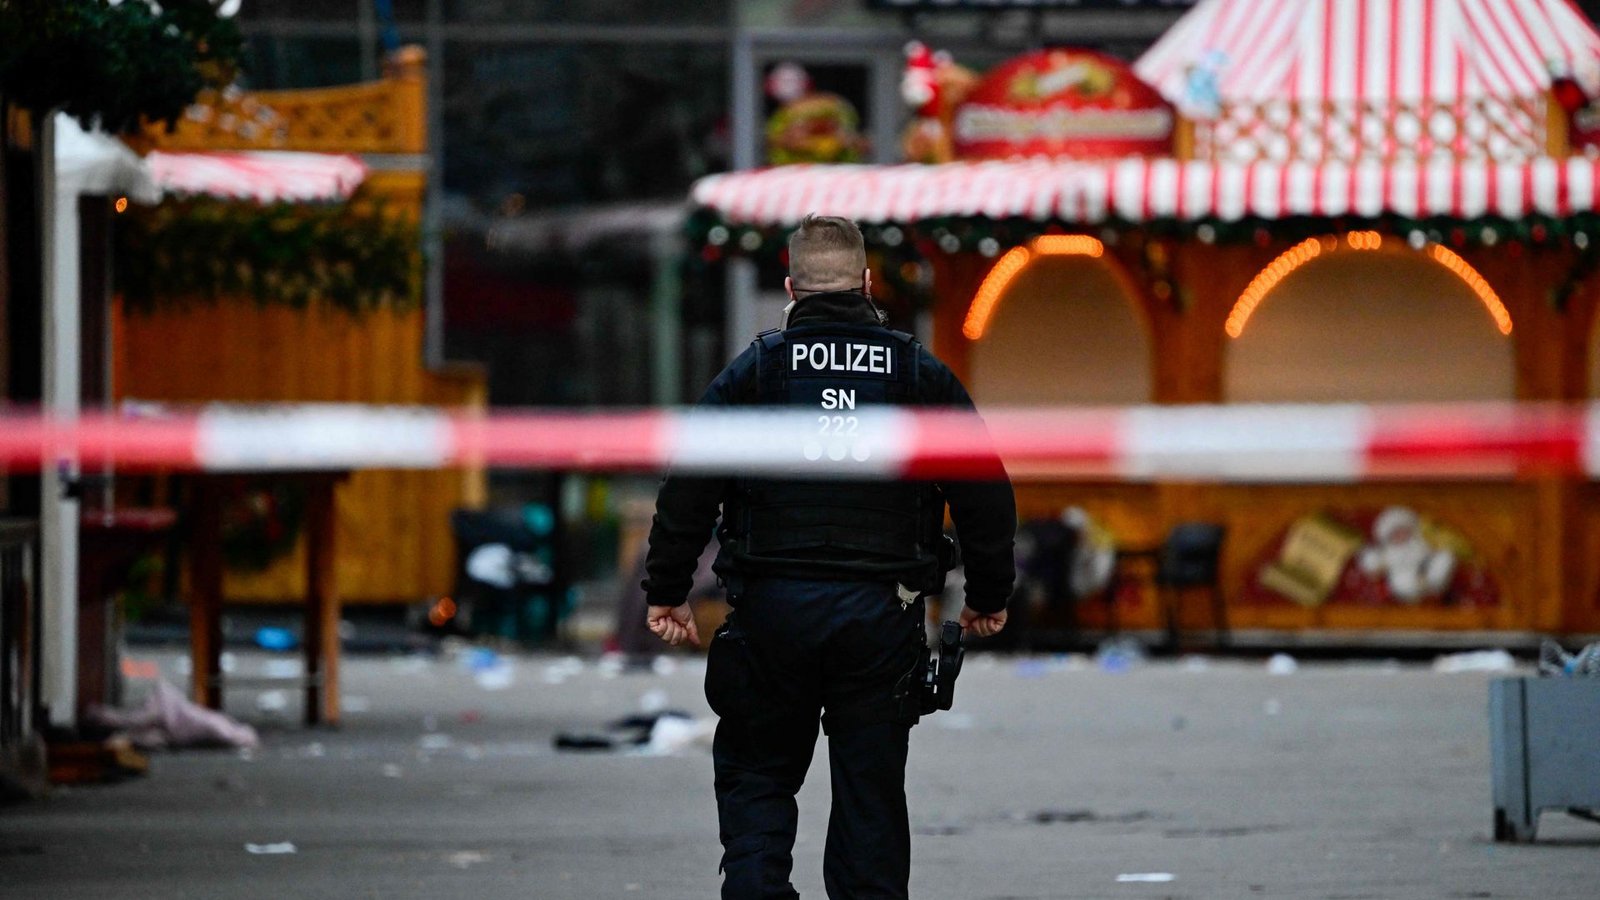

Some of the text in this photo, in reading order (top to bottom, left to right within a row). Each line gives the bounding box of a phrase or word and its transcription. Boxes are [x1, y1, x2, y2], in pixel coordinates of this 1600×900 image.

[792, 343, 891, 374] POLIZEI
[821, 388, 856, 410] SN
[818, 415, 859, 437] 222
